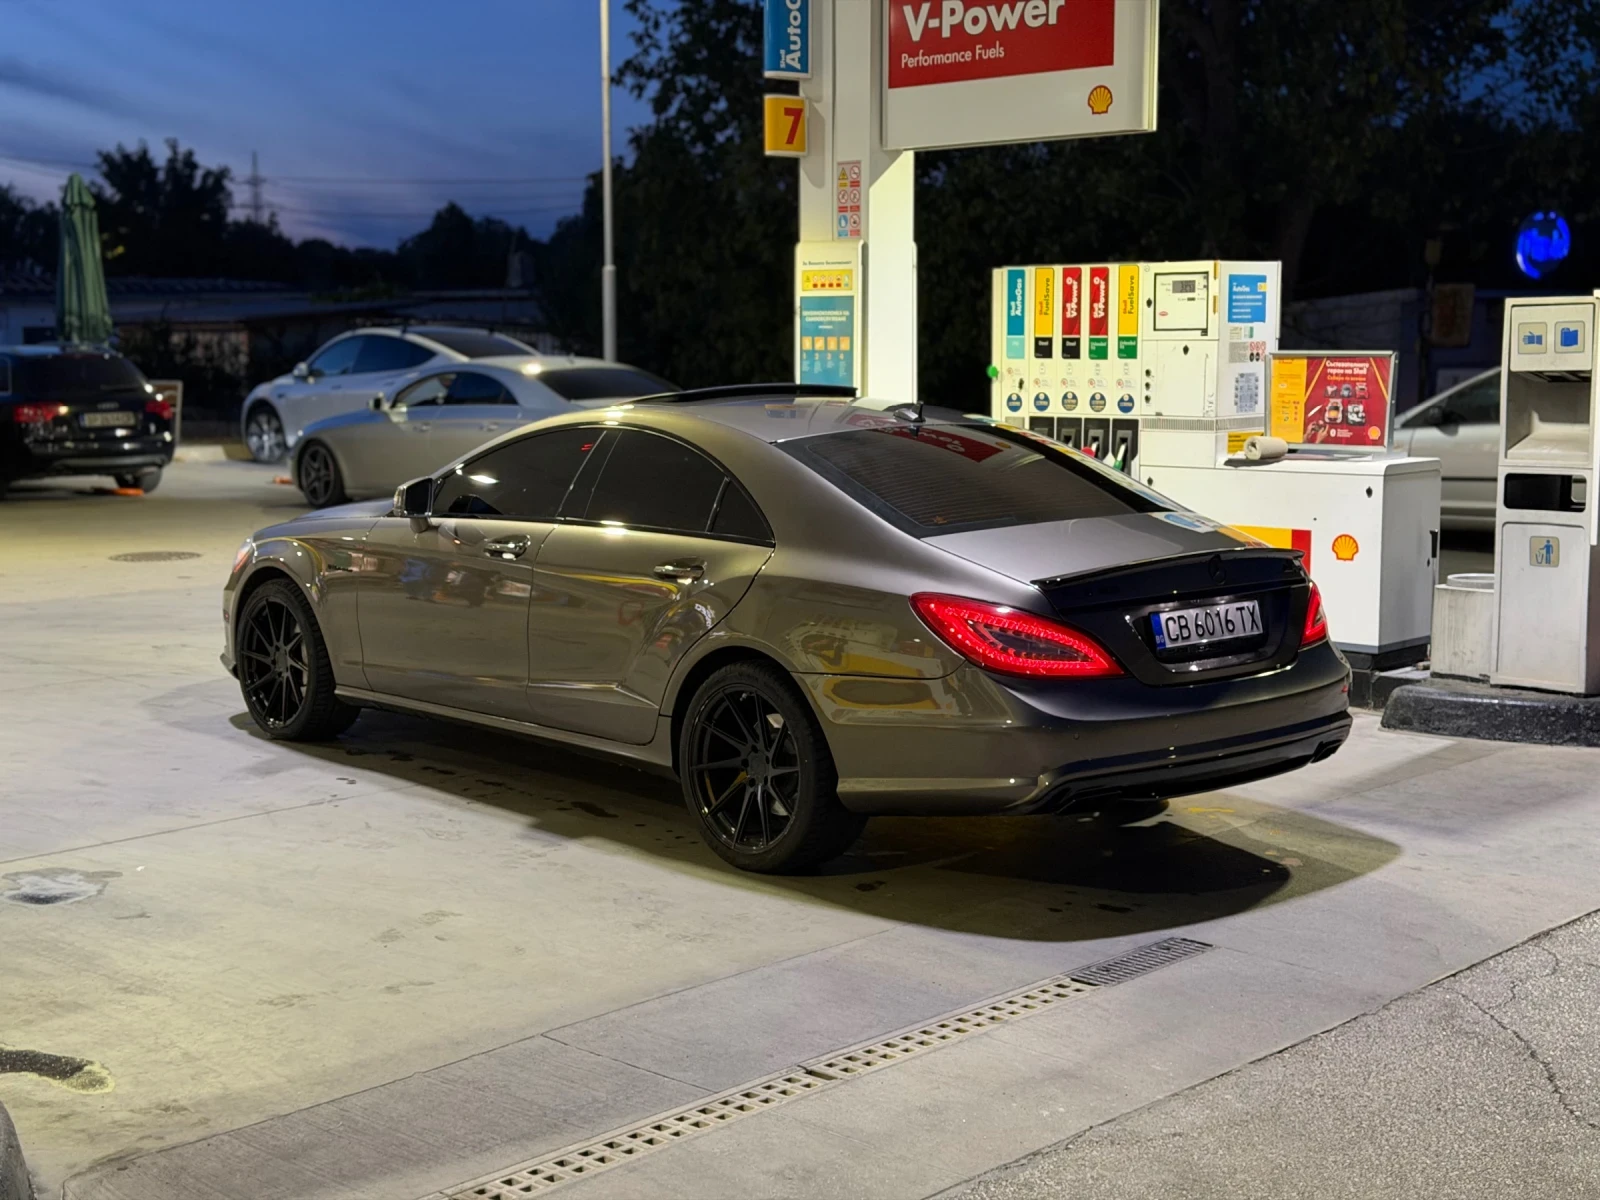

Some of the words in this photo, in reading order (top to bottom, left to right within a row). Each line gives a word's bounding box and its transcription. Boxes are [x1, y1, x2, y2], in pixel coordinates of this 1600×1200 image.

[903, 0, 1065, 42] V-Power
[901, 50, 972, 69] Performance
[975, 41, 1005, 61] Fuels
[783, 106, 804, 145] 7
[1015, 278, 1023, 316] AutoGas
[1165, 615, 1190, 642] CB
[1195, 608, 1235, 637] 6016
[1236, 605, 1259, 632] TX
